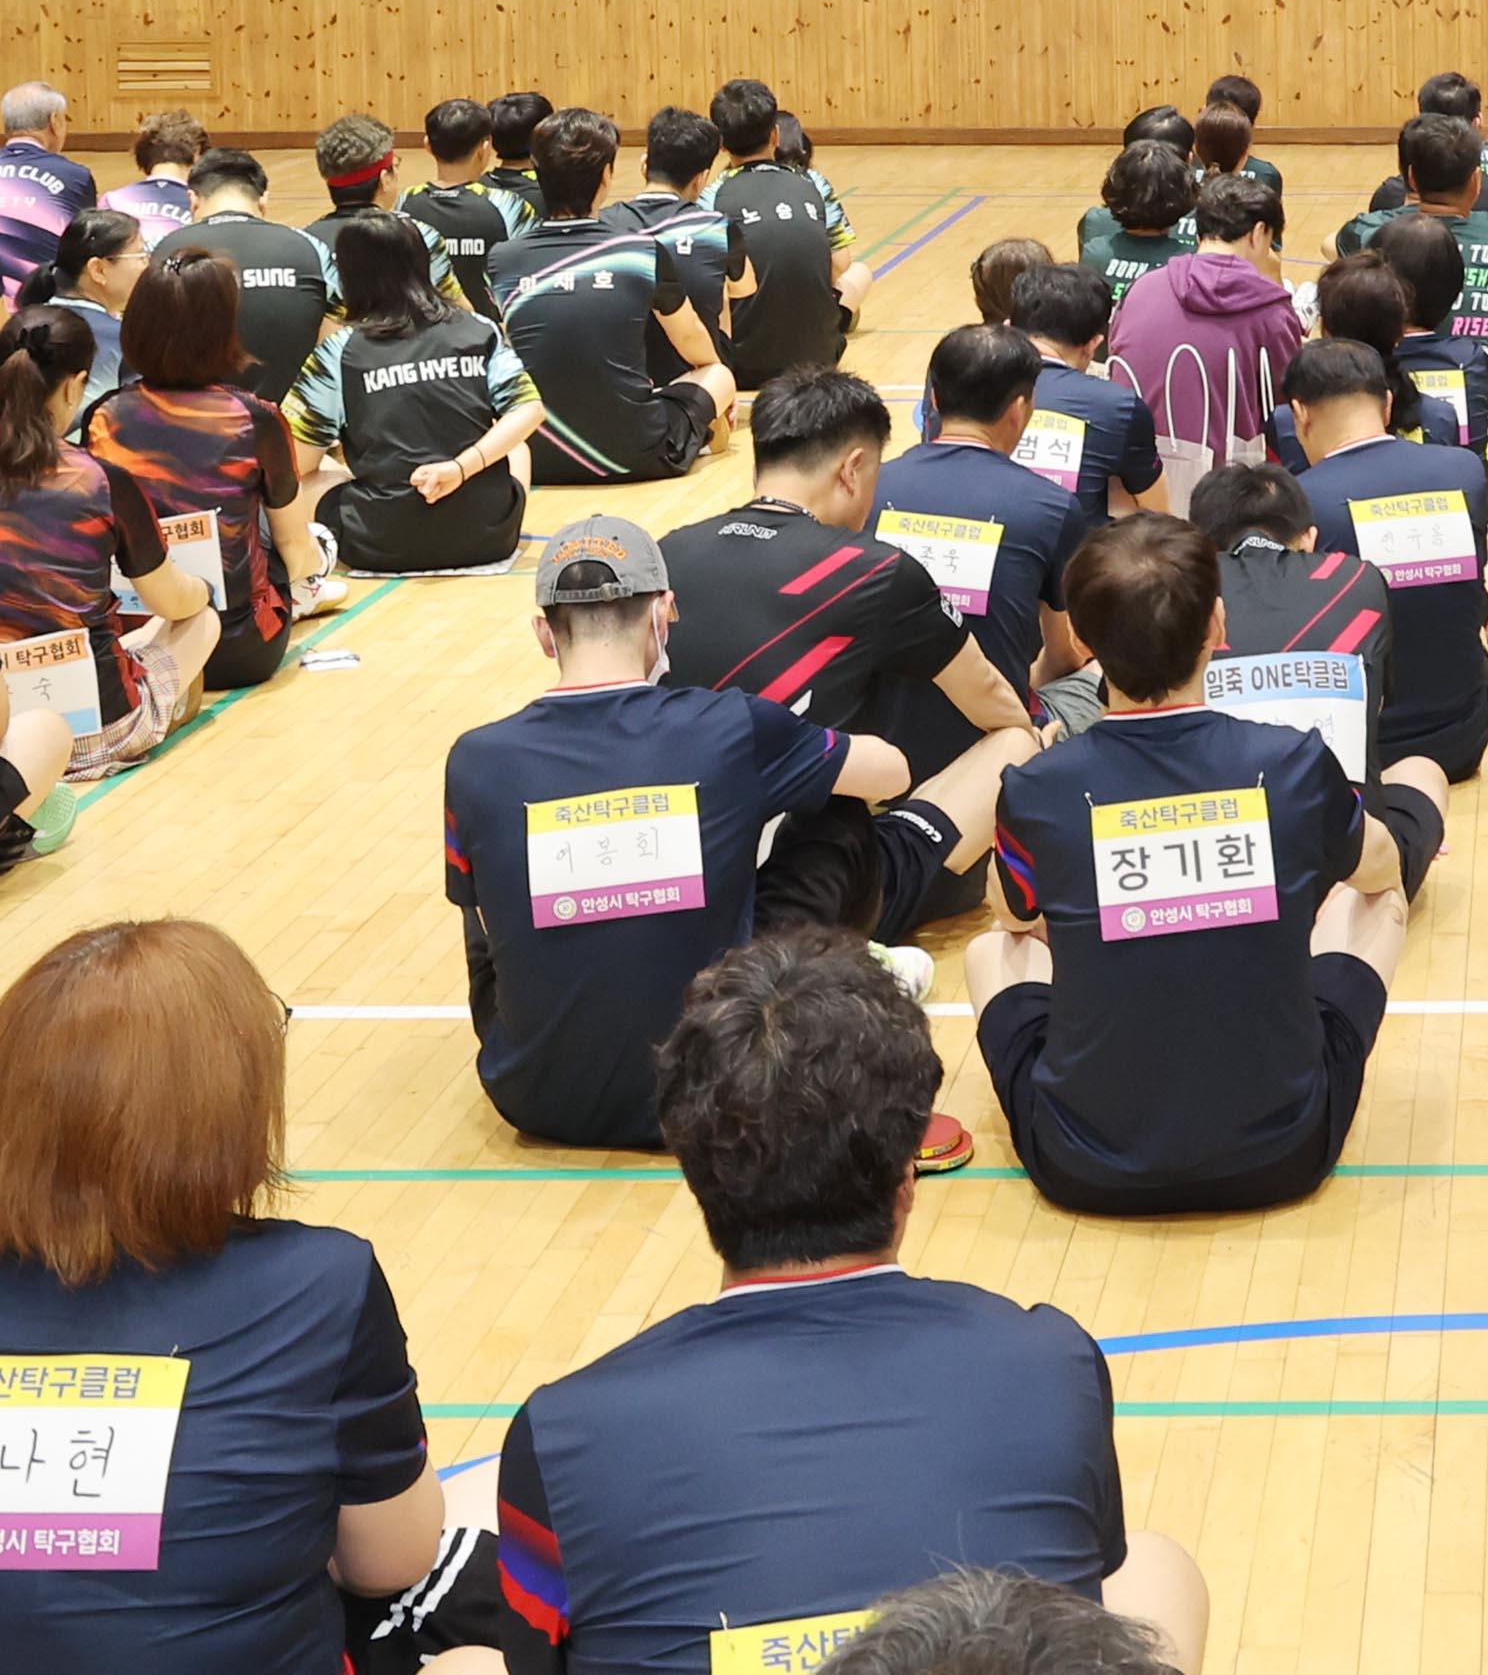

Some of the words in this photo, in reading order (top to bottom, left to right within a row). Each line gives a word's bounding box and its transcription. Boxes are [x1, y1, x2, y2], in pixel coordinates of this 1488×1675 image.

[18, 165, 66, 196] CLUB
[243, 268, 297, 288] SUNG
[362, 362, 415, 393] KANG
[418, 358, 457, 385] HYE
[461, 356, 486, 379] OK
[1394, 566, 1423, 582] 안성시
[1424, 563, 1462, 578] 탁구협회
[15, 637, 82, 668] 탁구협회
[1206, 665, 1243, 699] 일죽
[1251, 660, 1348, 691] ONE탁클럽
[554, 792, 670, 824] 죽산탁구클럽
[1118, 798, 1241, 830] 죽산탁구클럽
[1109, 833, 1258, 893] 장기환
[581, 893, 623, 914] 안성시
[625, 887, 681, 910] 탁구협회
[1148, 904, 1192, 927] 안성시
[1195, 898, 1254, 923] 탁구협회
[34, 1525, 120, 1556] 탁구협회
